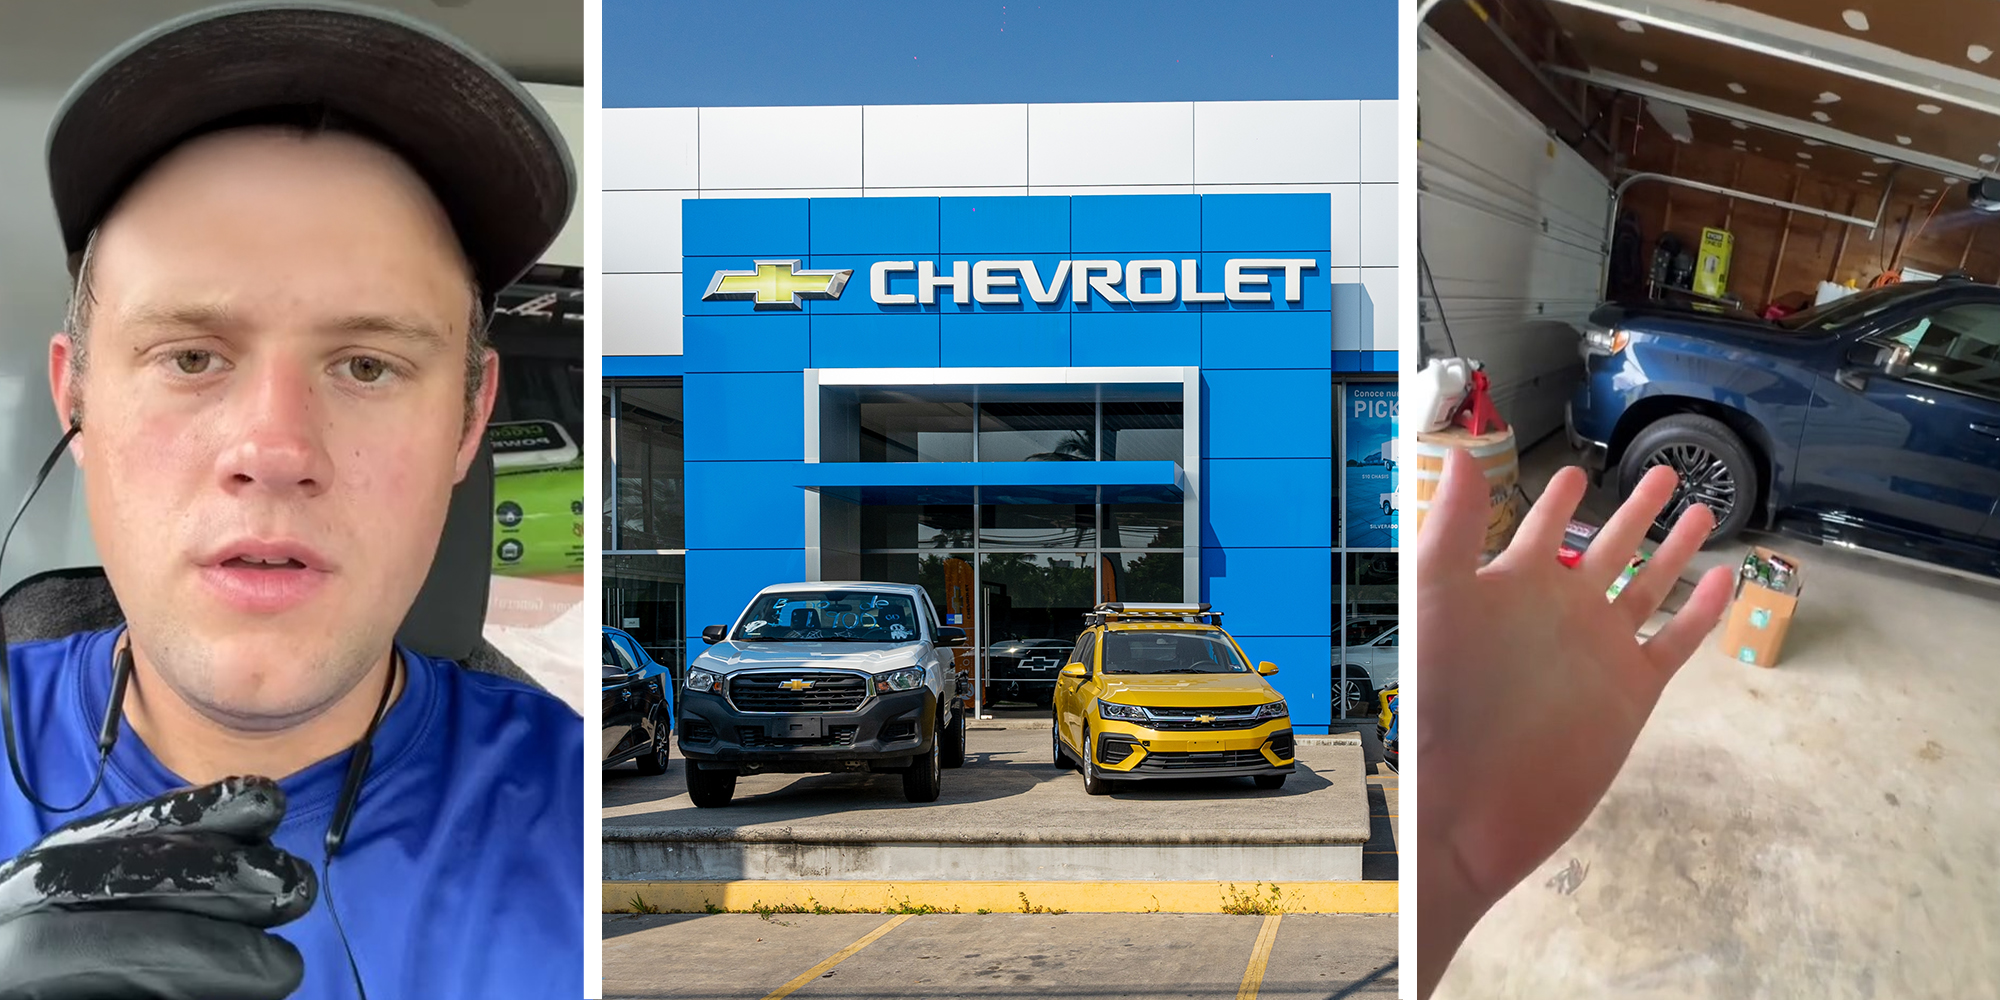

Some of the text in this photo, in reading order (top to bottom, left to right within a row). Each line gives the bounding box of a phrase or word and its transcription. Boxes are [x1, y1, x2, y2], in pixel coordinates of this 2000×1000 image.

[869, 258, 1316, 305] CHEVROLET
[1354, 389, 1384, 398] Conoce
[1354, 400, 1399, 418] PICK
[859, 595, 889, 610] de
